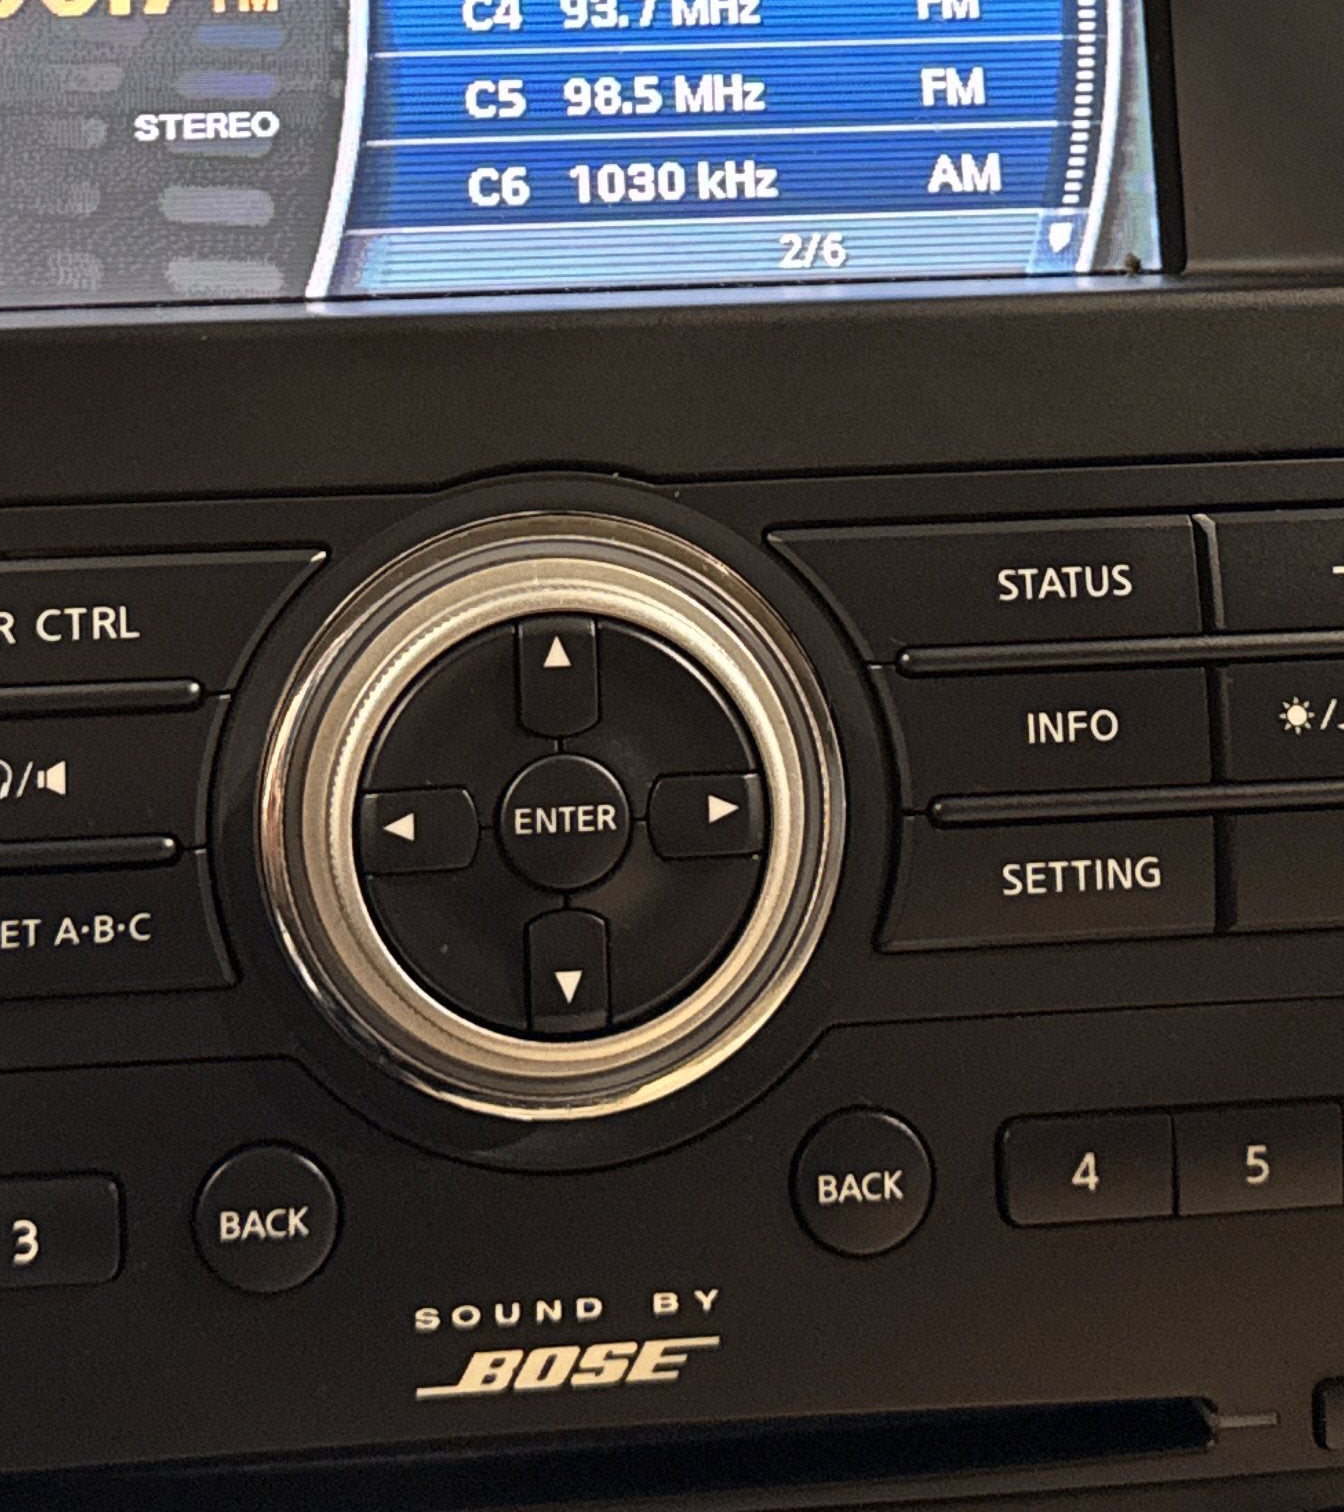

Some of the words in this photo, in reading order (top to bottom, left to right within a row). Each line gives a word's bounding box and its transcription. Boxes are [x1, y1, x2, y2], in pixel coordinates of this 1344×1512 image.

[465, 80, 527, 118] C5
[564, 76, 663, 115] 98.5
[674, 74, 765, 112] MHz
[921, 68, 986, 105] FM
[134, 111, 280, 141] STEREO
[468, 167, 530, 207] C6
[570, 163, 686, 203] 1030
[697, 160, 779, 198] kHz
[928, 154, 1002, 192] AM
[779, 234, 847, 268] 2/6
[998, 564, 1133, 601] STATUS
[35, 605, 141, 641] CTRL
[1027, 709, 1119, 744] INFO
[514, 804, 617, 835] ENTER
[1002, 857, 1162, 896] SETTING
[1072, 1152, 1099, 1190] 4
[1246, 1144, 1270, 1184] 5
[817, 1169, 904, 1204] BACK
[11, 1219, 39, 1266] 3
[220, 1206, 309, 1242] BACK
[414, 1296, 603, 1331] SOUND
[652, 1288, 719, 1315] BY
[416, 1335, 720, 1400] BOSE
